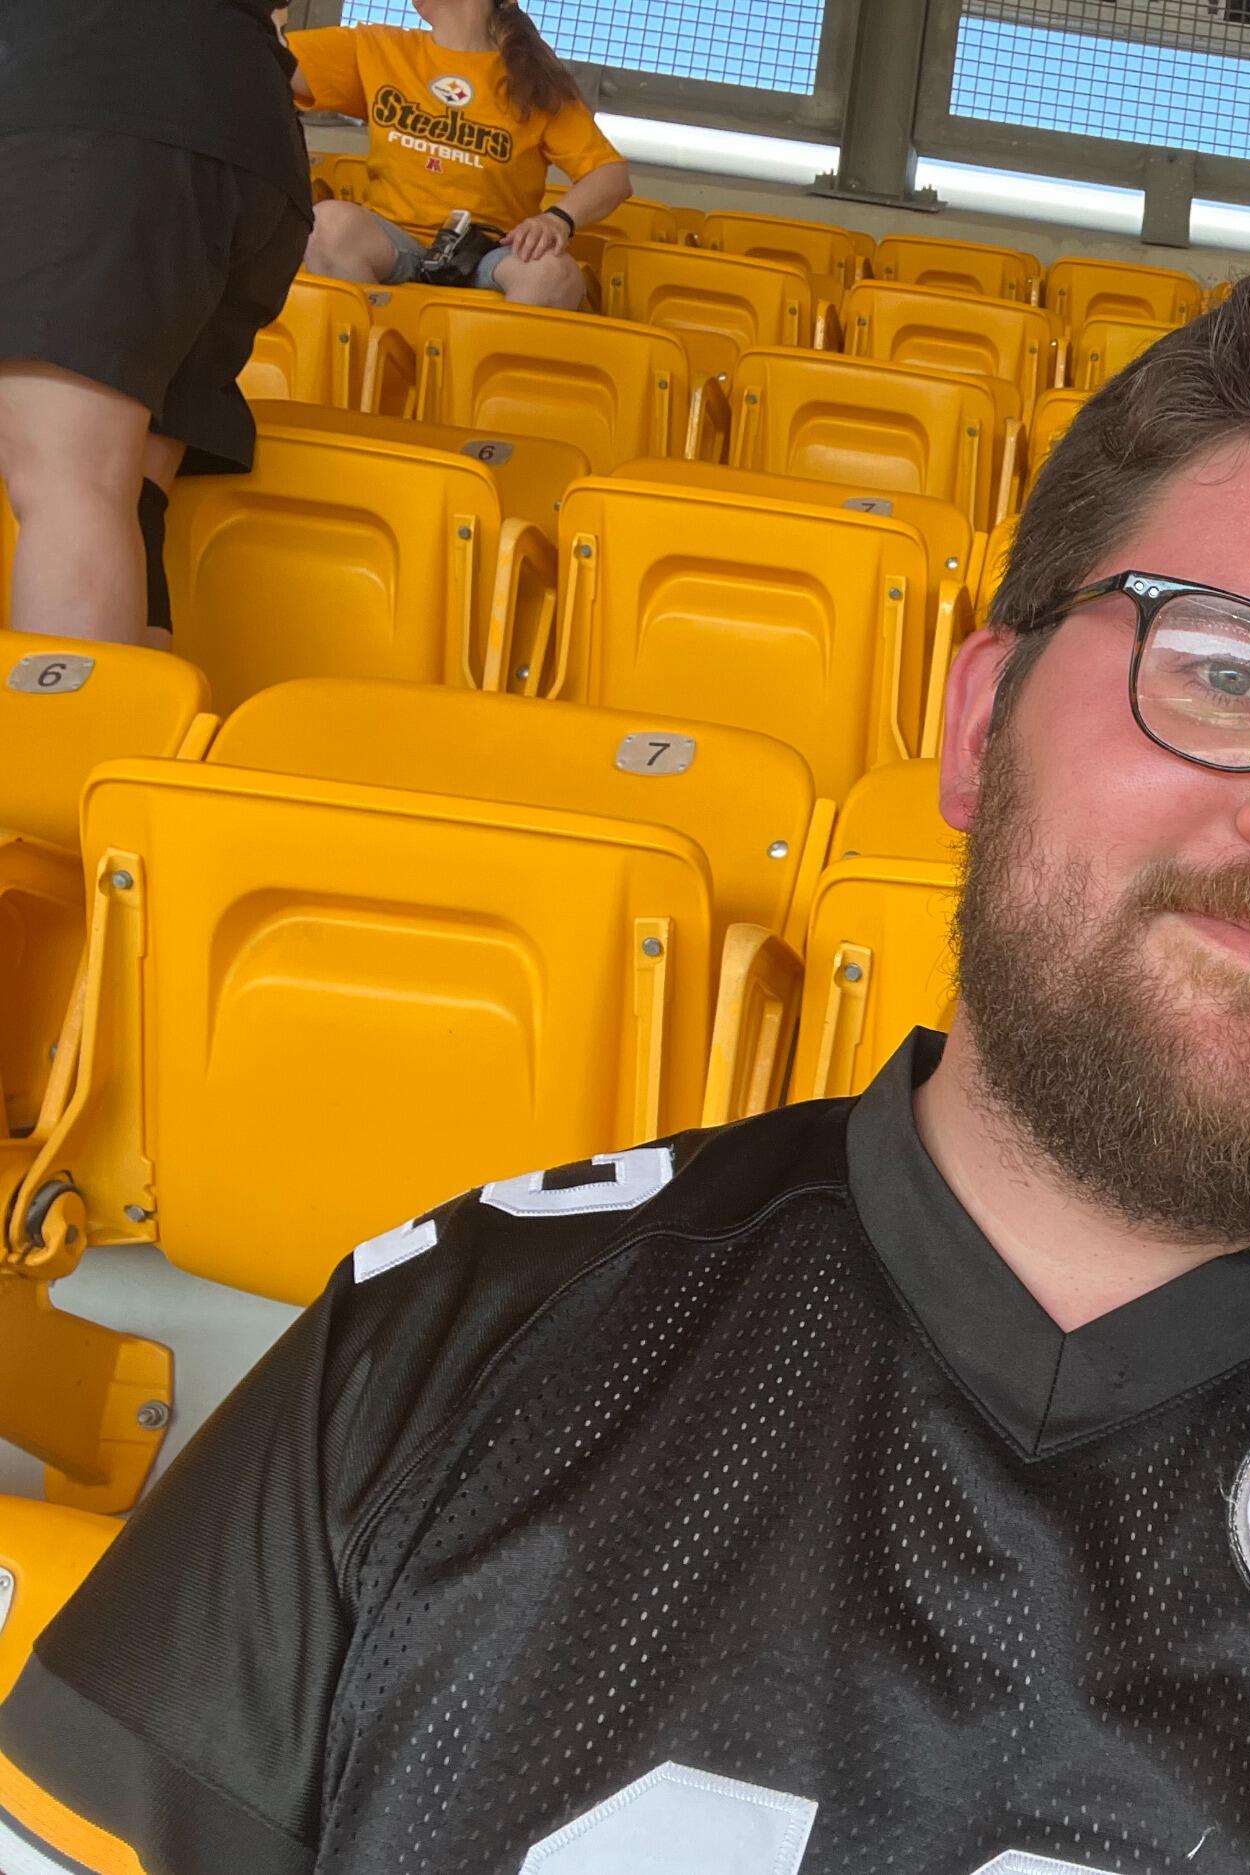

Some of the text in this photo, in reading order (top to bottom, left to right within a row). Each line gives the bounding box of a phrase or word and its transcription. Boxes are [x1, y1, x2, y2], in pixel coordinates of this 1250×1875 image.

[373, 86, 512, 162] Steelers
[388, 130, 484, 169] FOOTBALL
[478, 445, 496, 461] 6
[38, 663, 67, 687] 6
[646, 742, 671, 766] 7
